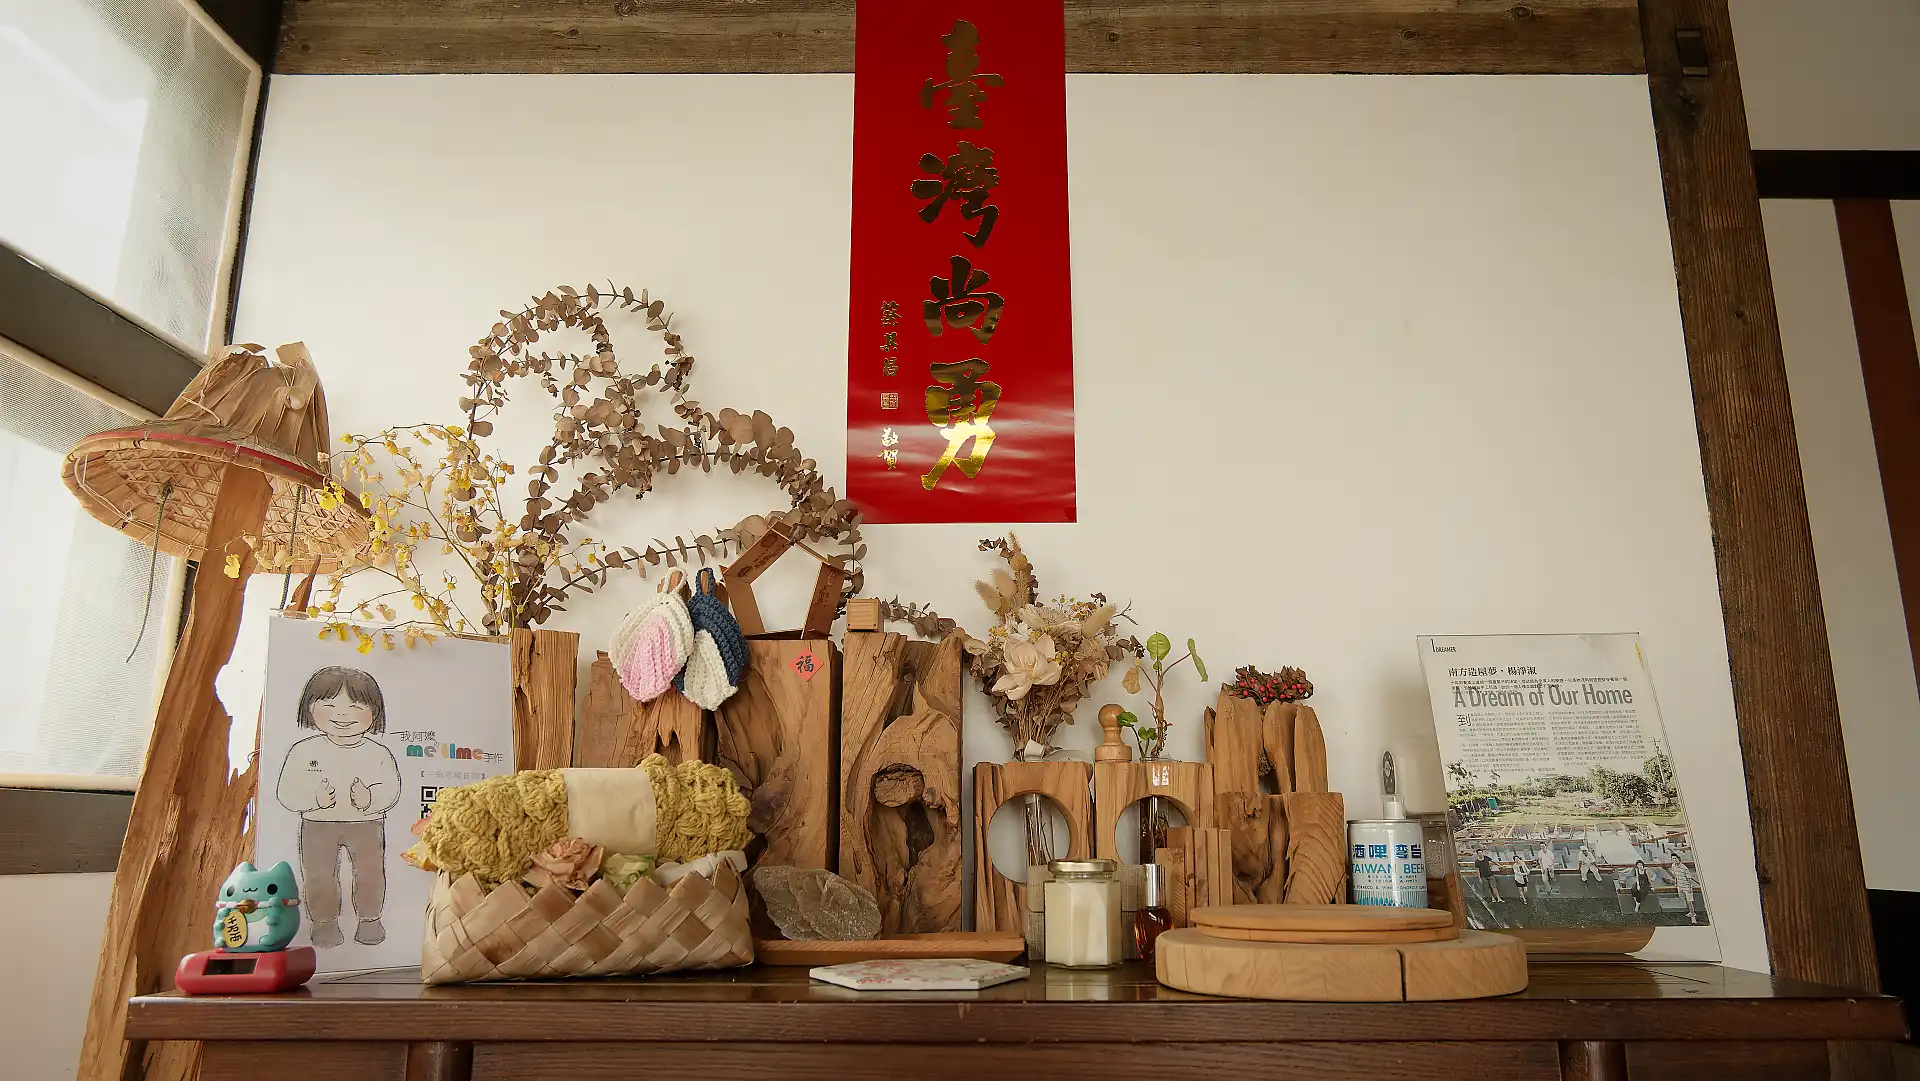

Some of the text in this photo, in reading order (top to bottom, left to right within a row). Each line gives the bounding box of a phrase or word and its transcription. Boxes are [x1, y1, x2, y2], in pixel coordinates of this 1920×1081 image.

[795, 655, 815, 673] 福
[1454, 686, 1466, 708] A
[1468, 686, 1525, 707] Dream
[1528, 683, 1545, 706] of
[1548, 685, 1579, 706] Our
[1582, 683, 1633, 705] Home
[406, 744, 437, 758] me
[1404, 863, 1425, 874] BEER
